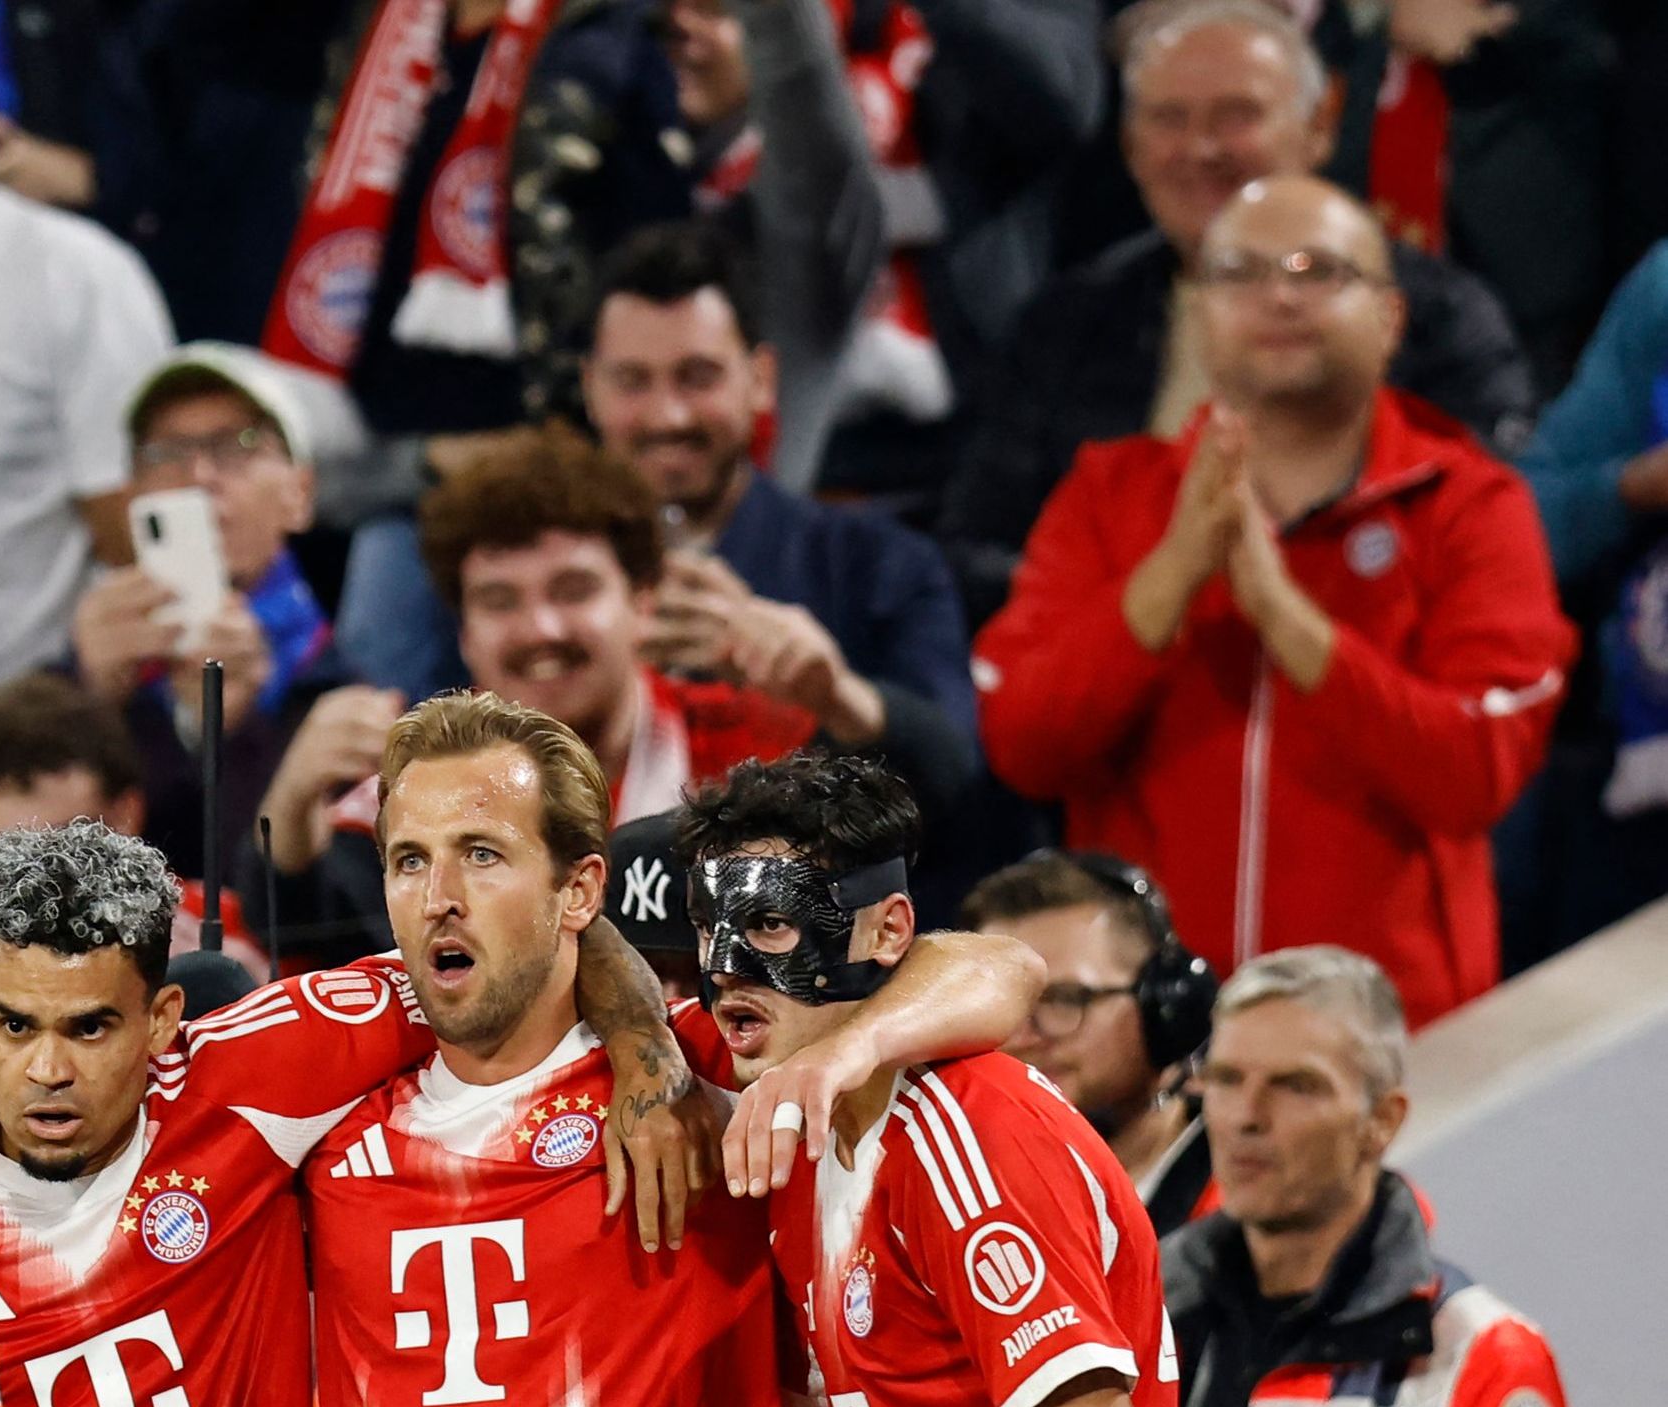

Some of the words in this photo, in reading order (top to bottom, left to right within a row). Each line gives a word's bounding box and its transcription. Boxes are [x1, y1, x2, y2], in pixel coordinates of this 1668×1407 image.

[621, 856, 672, 922] NY
[550, 1118, 593, 1133] BAYERN
[149, 1196, 196, 1217] BAYERN
[145, 1217, 155, 1235] FC
[154, 1222, 205, 1259] MÜNCHEN
[390, 1218, 529, 1407] T
[1000, 1305, 1081, 1368] Allianz
